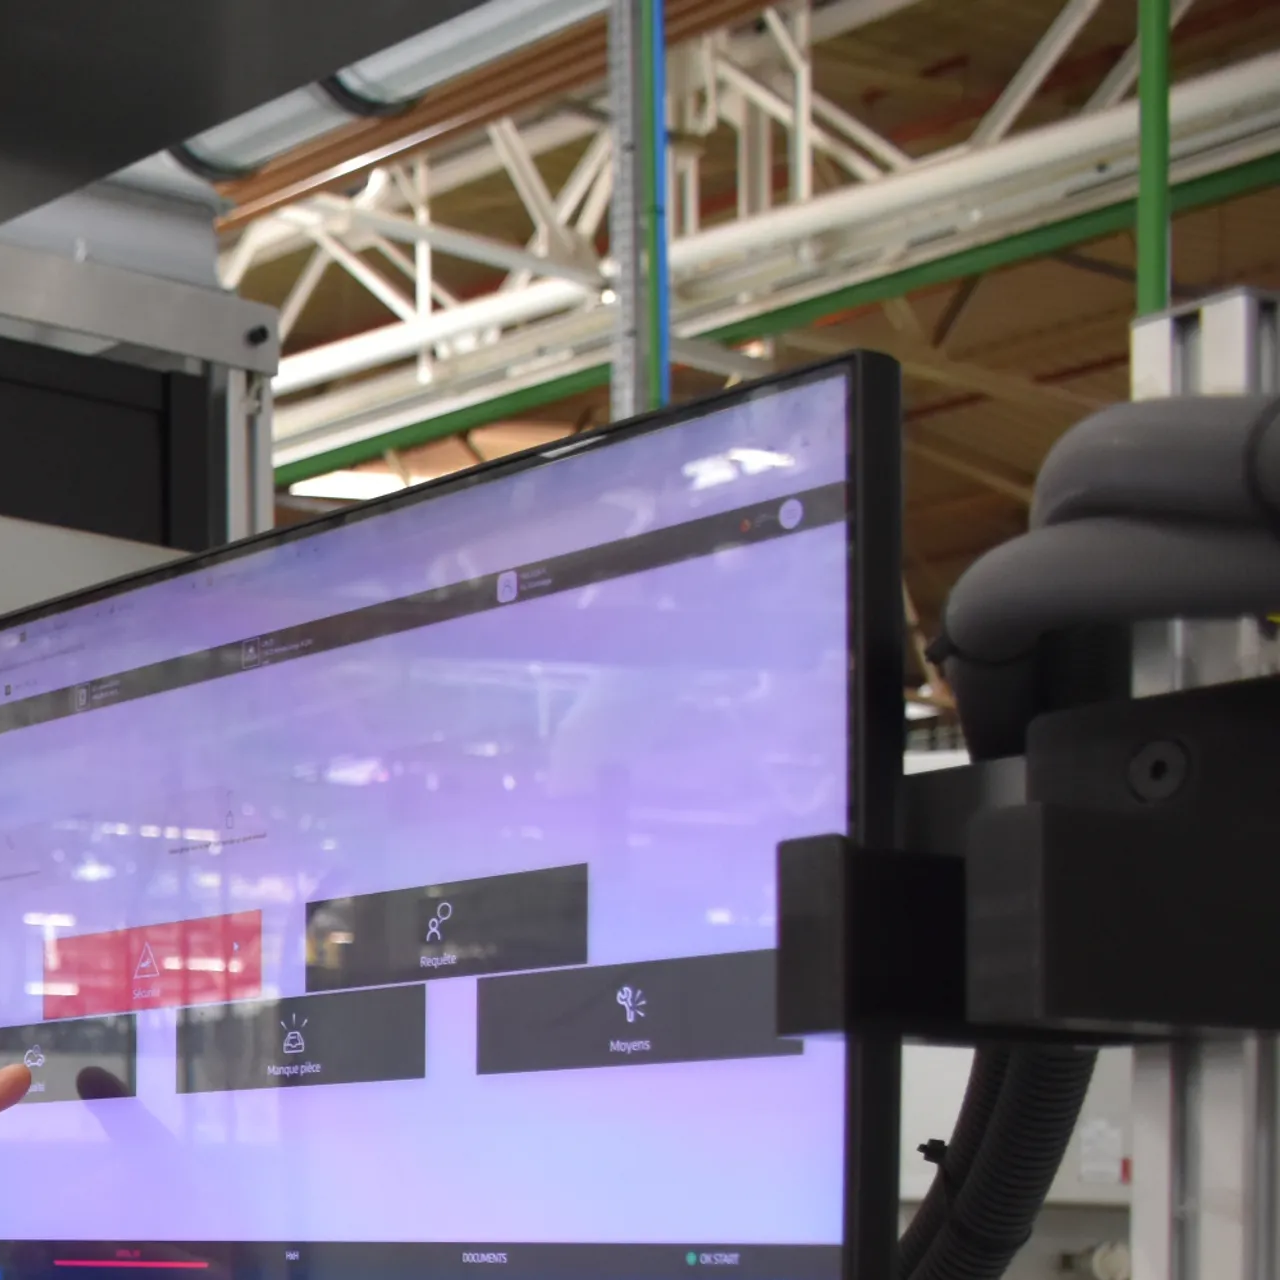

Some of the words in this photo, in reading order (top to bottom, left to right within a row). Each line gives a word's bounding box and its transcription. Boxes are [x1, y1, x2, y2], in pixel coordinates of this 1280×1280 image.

[420, 952, 457, 968] Requête
[609, 1039, 651, 1054] Moyens
[267, 1064, 298, 1076] Manque
[299, 1062, 321, 1075] pièce
[462, 1252, 507, 1264] DOCUMENTS
[713, 1252, 740, 1265] START
